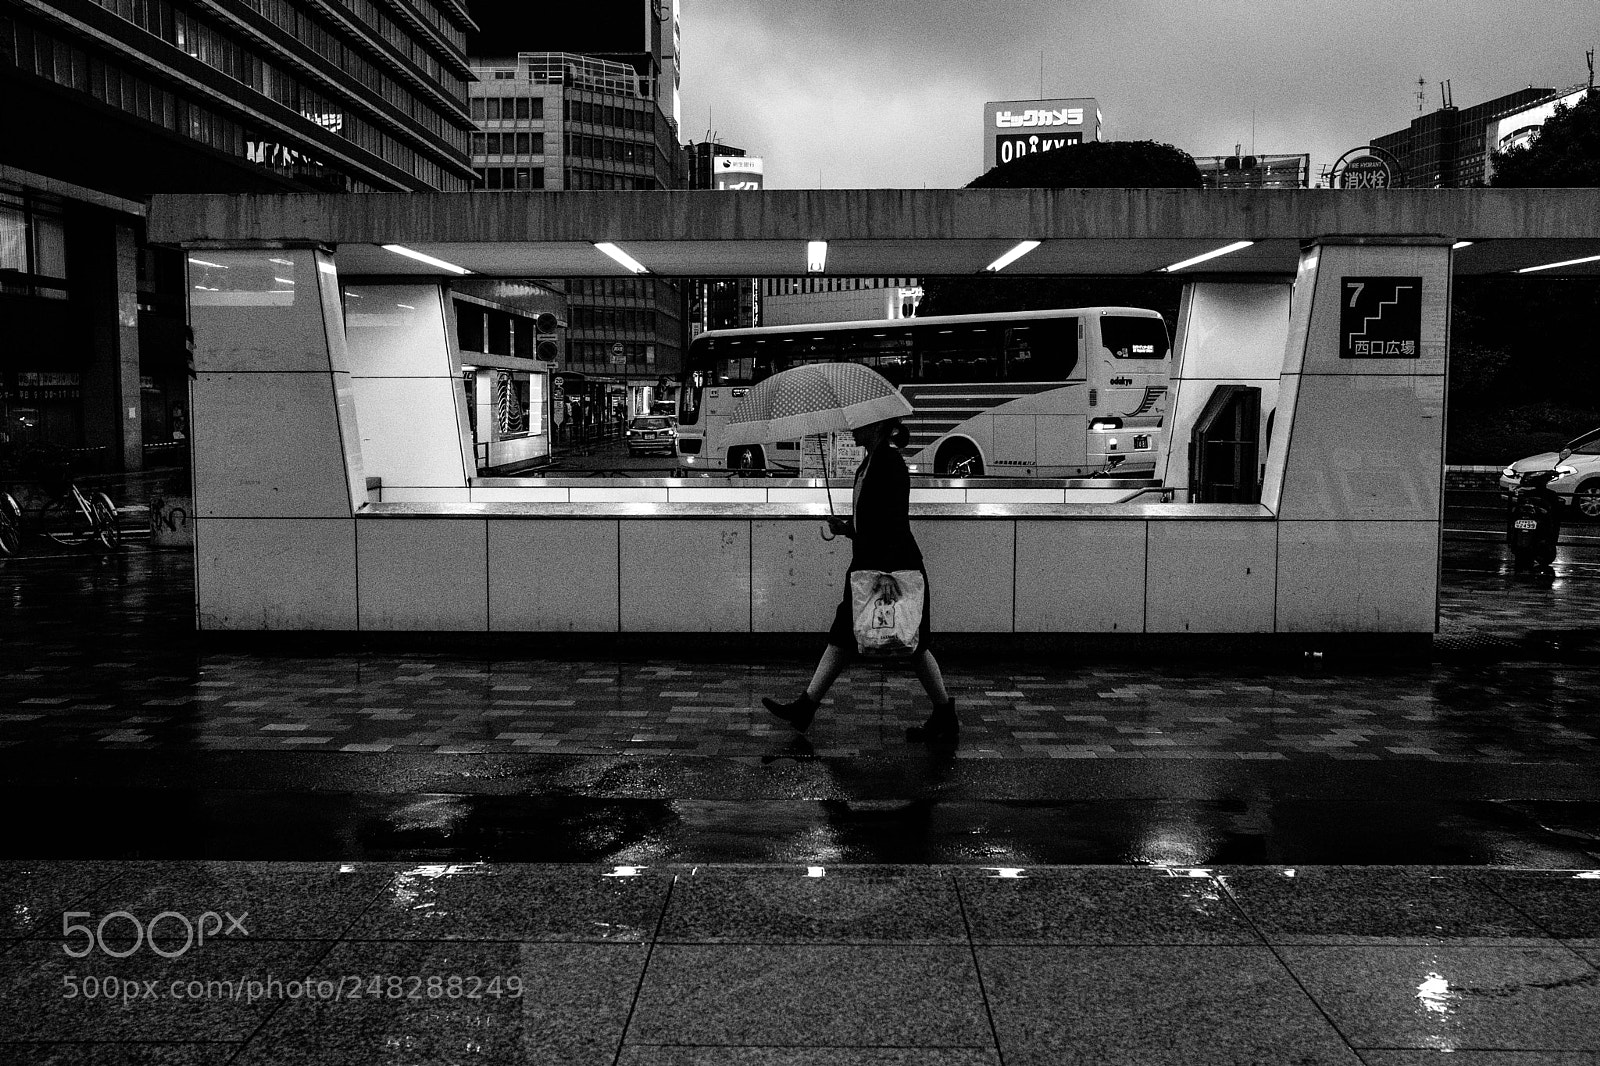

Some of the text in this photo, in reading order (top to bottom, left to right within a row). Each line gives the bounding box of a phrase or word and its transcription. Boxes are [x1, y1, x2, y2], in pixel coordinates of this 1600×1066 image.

[996, 108, 1084, 128] ビックカメラ
[1001, 135, 1078, 163] ODAK
[1344, 170, 1386, 190] 消火栓
[1347, 282, 1365, 308] 7
[1354, 340, 1415, 355] 西口広場
